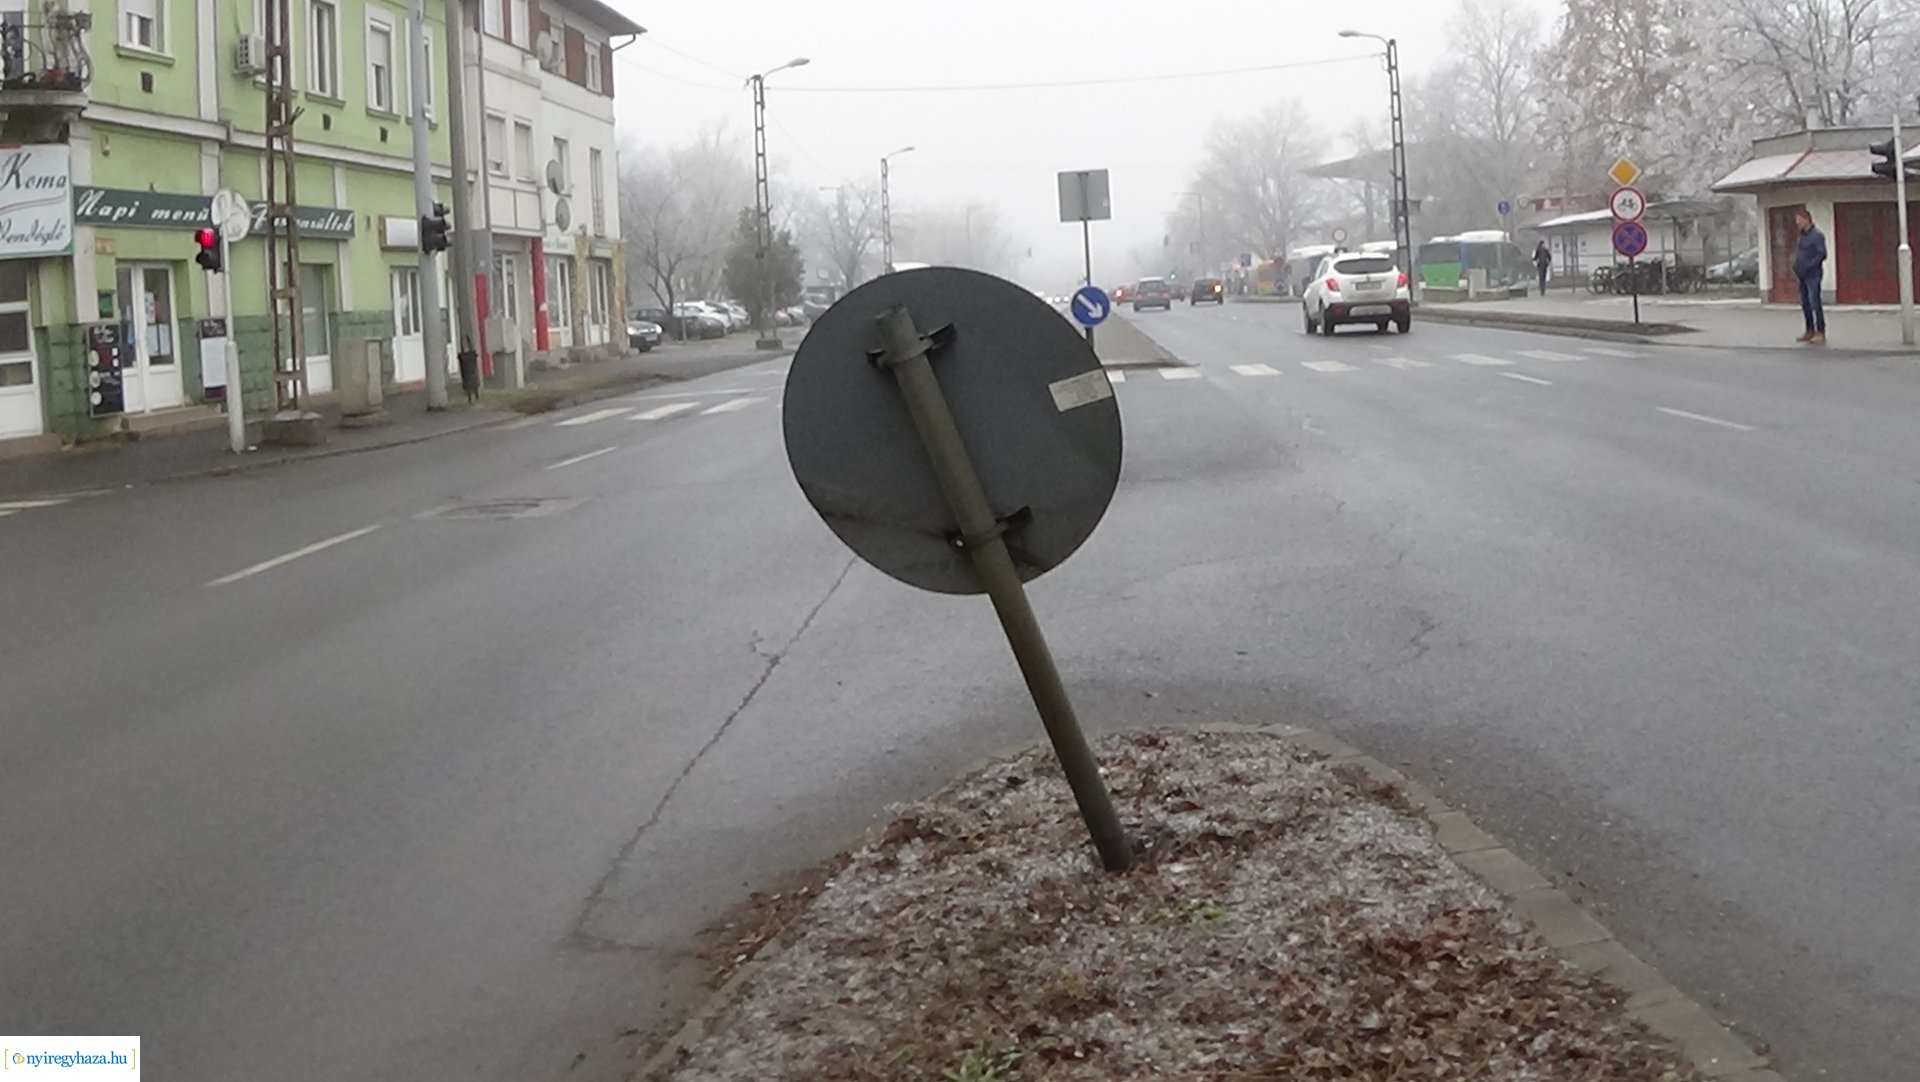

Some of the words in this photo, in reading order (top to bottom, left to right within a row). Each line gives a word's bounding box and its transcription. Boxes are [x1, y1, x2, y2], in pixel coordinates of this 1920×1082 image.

[0, 152, 67, 190] Koma
[75, 189, 139, 221] Napi
[150, 207, 210, 221] menü
